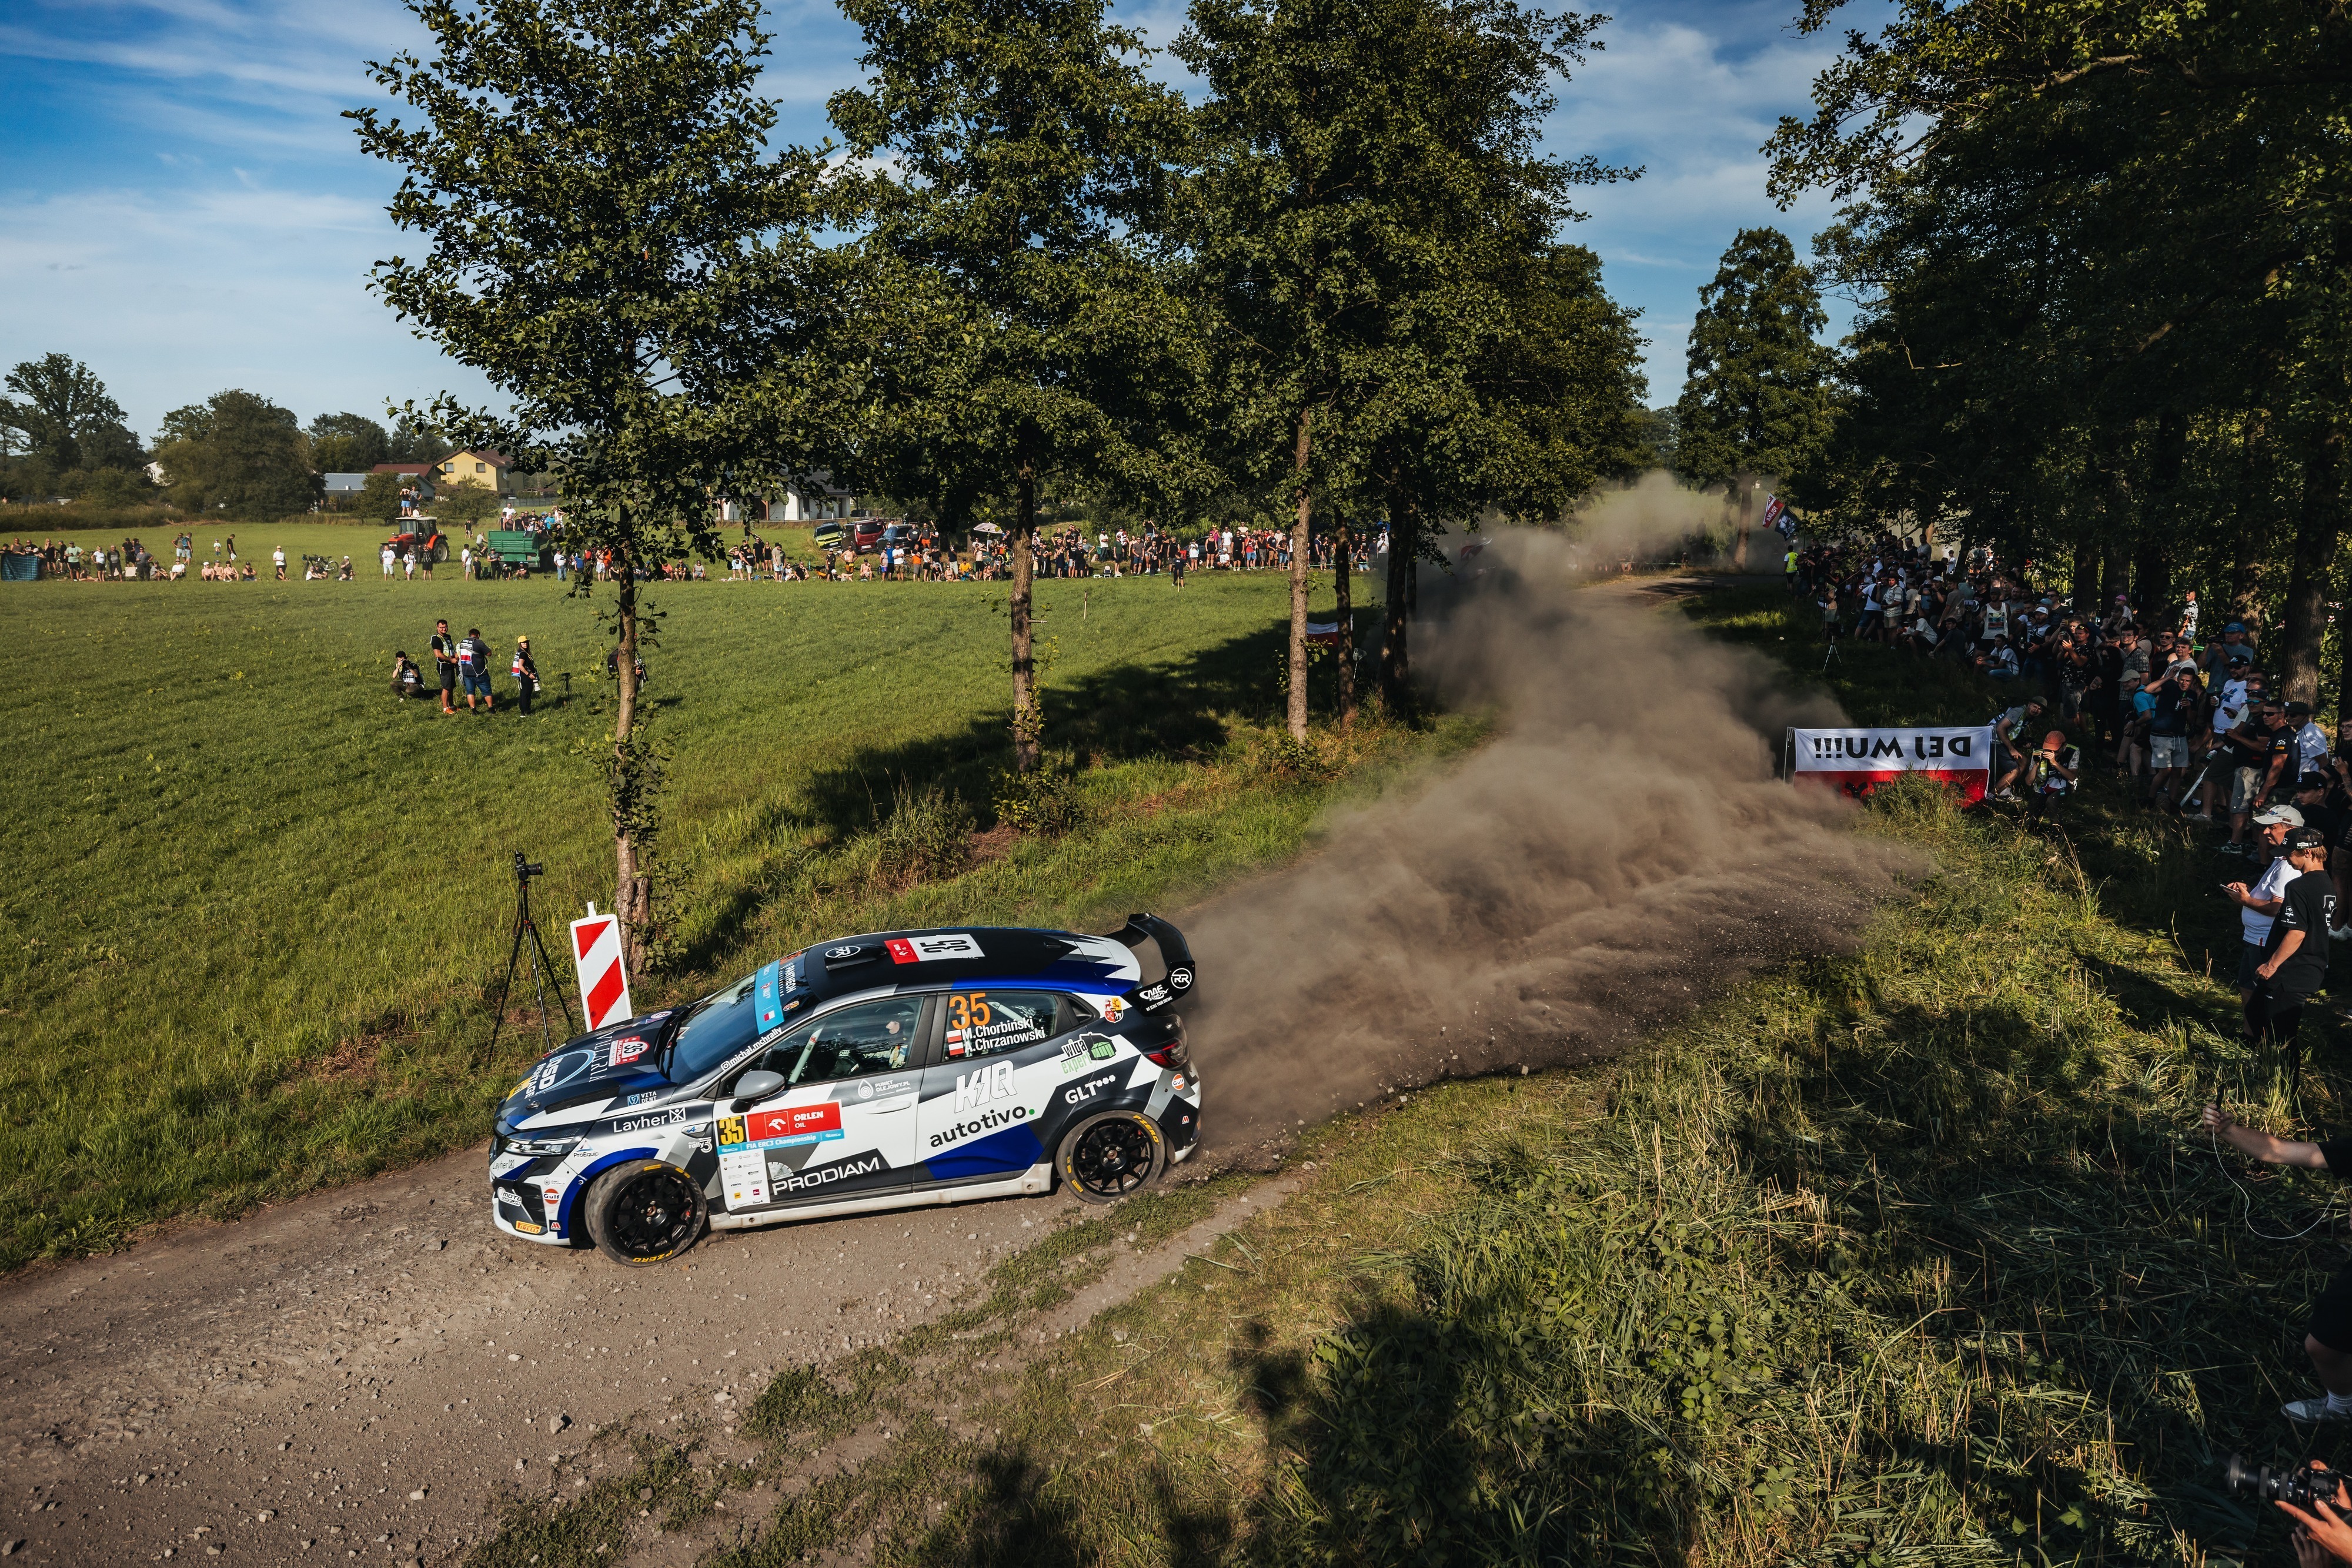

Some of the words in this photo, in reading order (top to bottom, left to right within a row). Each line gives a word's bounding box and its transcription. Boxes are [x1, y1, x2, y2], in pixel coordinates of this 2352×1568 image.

[920, 940, 971, 953] 35
[786, 965, 797, 994] PANTHEON
[1174, 974, 1189, 983] RR
[949, 993, 991, 1029] 35
[961, 1016, 1034, 1041] M.Chorbiński
[624, 1044, 643, 1054] 35
[729, 1027, 782, 1066] michal.mchrally
[964, 1027, 1045, 1053] A.Chrzanowski
[1063, 1039, 1087, 1057] wiga
[1061, 1052, 1093, 1074] expert
[876, 1081, 910, 1092] OLEJOWY.PL
[1065, 1080, 1097, 1104] GLT
[613, 1115, 667, 1133] Layher
[794, 1111, 823, 1122] ORLEN
[719, 1116, 744, 1145] 35
[775, 1135, 816, 1145] Championship
[493, 1161, 509, 1171] Layher
[772, 1157, 880, 1195] PRODIAM
[517, 1222, 540, 1233] PIRELLI
